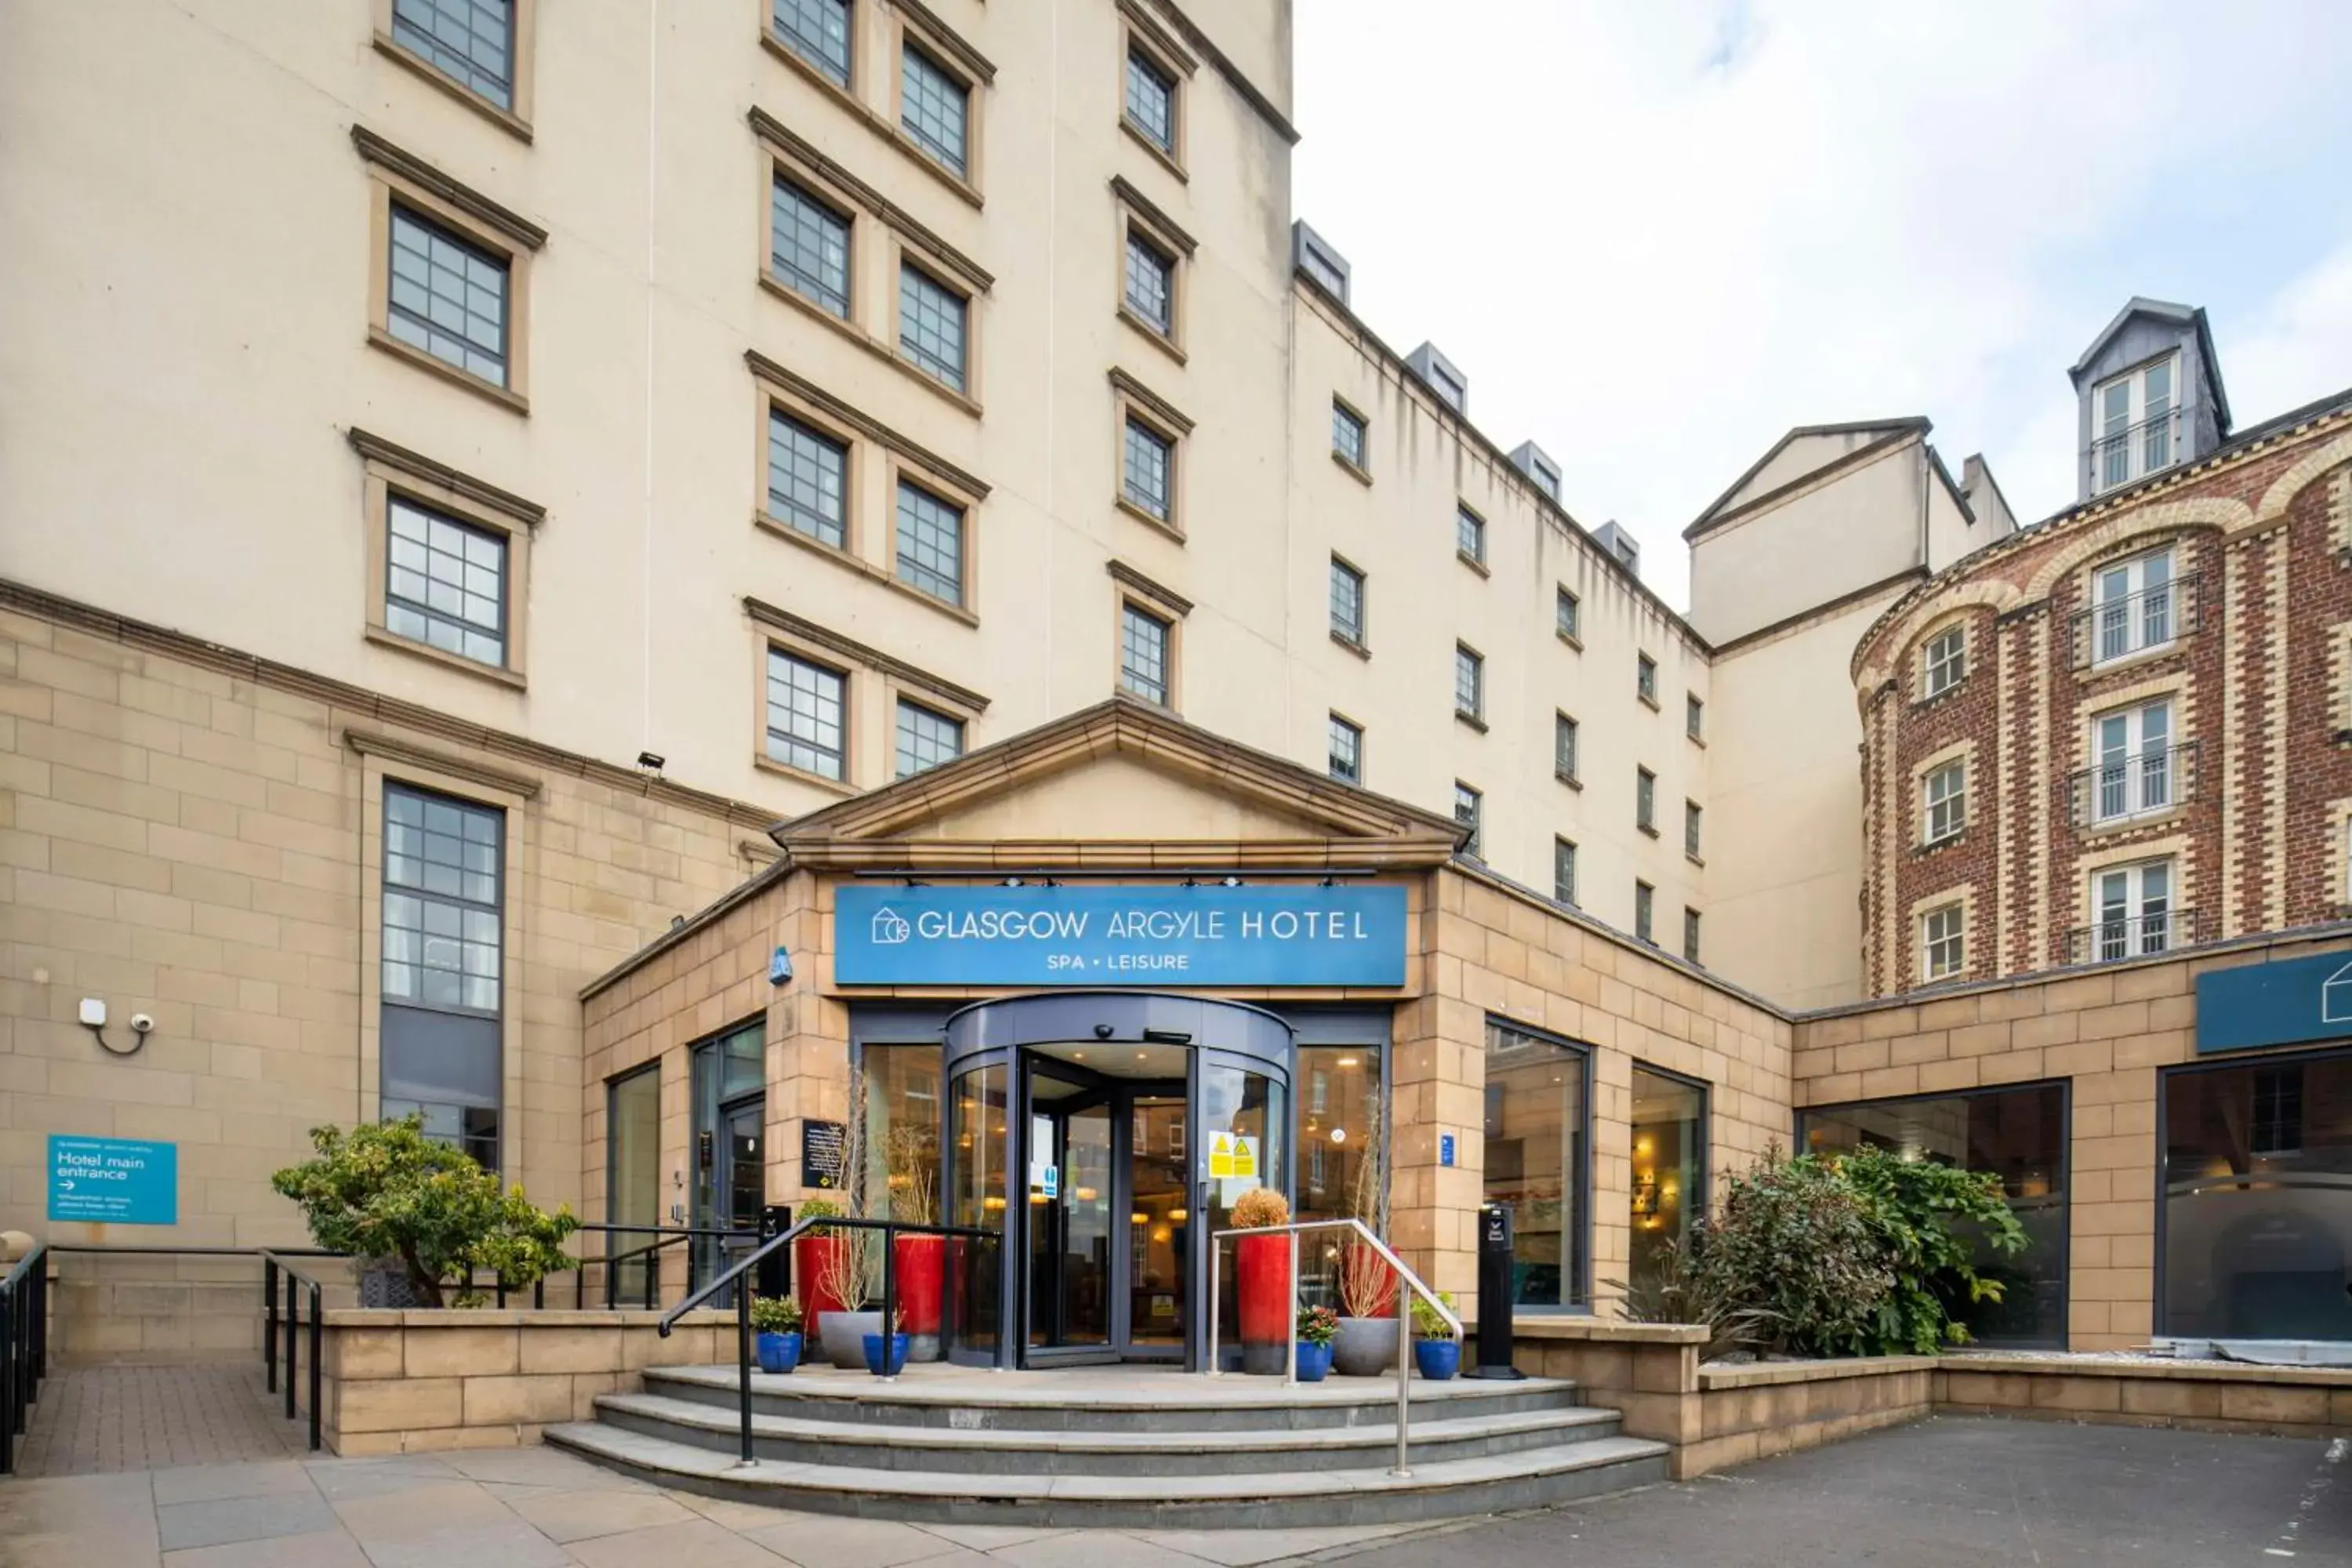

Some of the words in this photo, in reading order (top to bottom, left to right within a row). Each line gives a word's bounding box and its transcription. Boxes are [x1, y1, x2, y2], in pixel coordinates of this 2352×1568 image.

[917, 910, 1089, 940] GLASGOW
[1106, 910, 1225, 940] ARGYLE
[1241, 910, 1368, 940] HOTEL
[1047, 954, 1085, 970] SPA
[1107, 954, 1189, 971] LEISURE
[57, 1152, 101, 1166] Hotel
[107, 1156, 145, 1168] main
[57, 1167, 128, 1180] entrance
